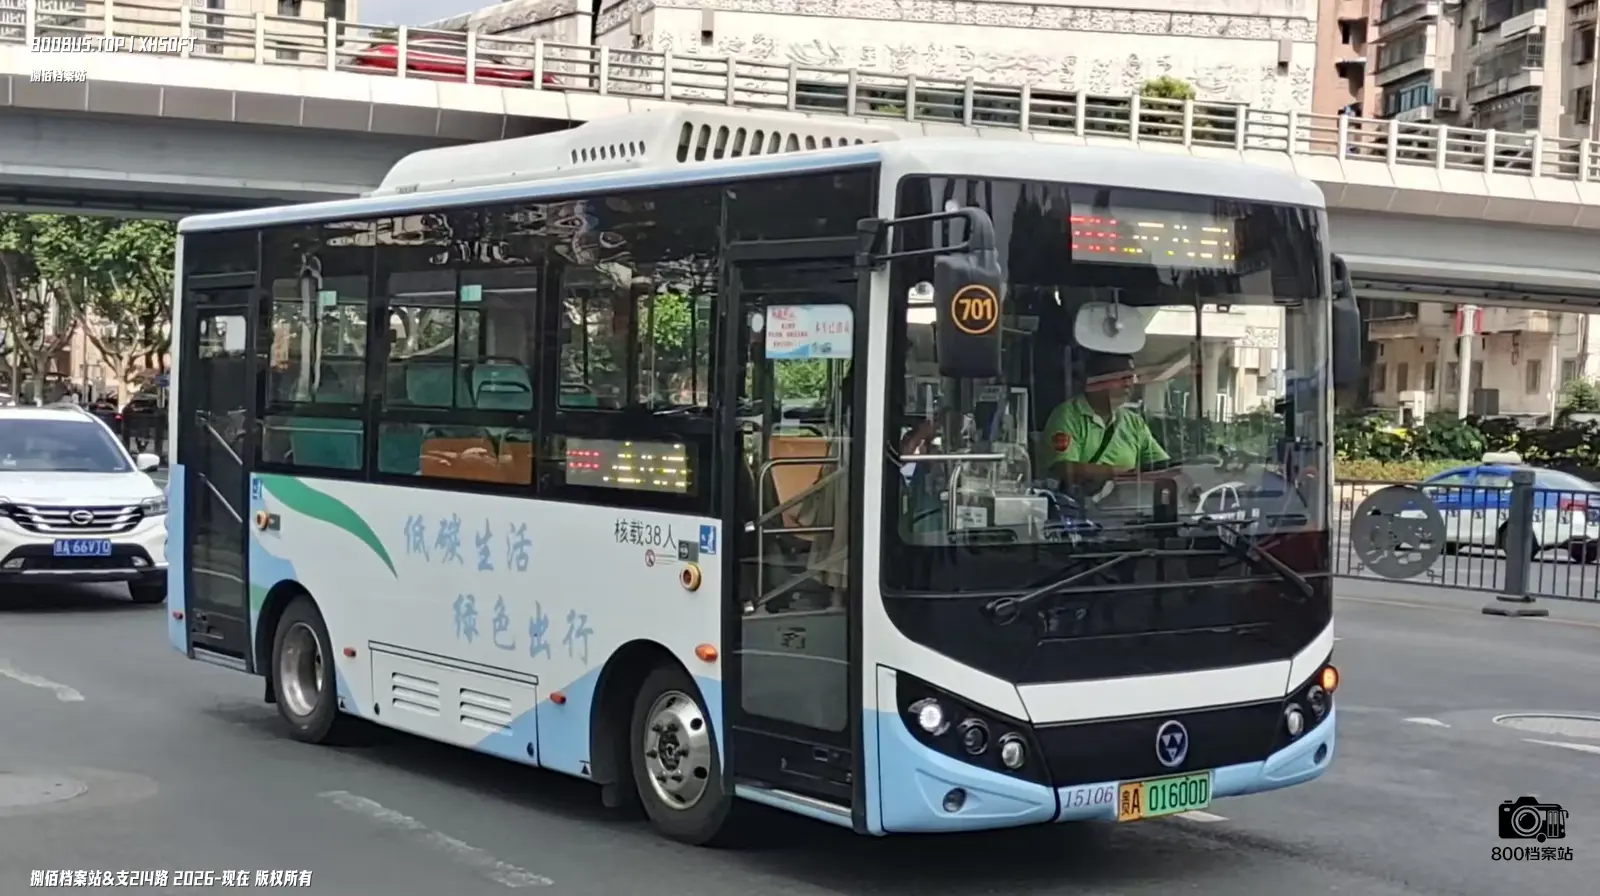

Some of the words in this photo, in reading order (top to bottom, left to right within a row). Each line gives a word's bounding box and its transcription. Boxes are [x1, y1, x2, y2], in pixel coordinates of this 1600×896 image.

[959, 298, 992, 320] 701
[403, 512, 532, 572] 低碳生活
[614, 518, 677, 550] 核载38人
[452, 593, 594, 666] 绿色出行
[1064, 785, 1114, 809] 15106
[1120, 787, 1141, 816] 贵A
[1148, 778, 1208, 812] 01600D
